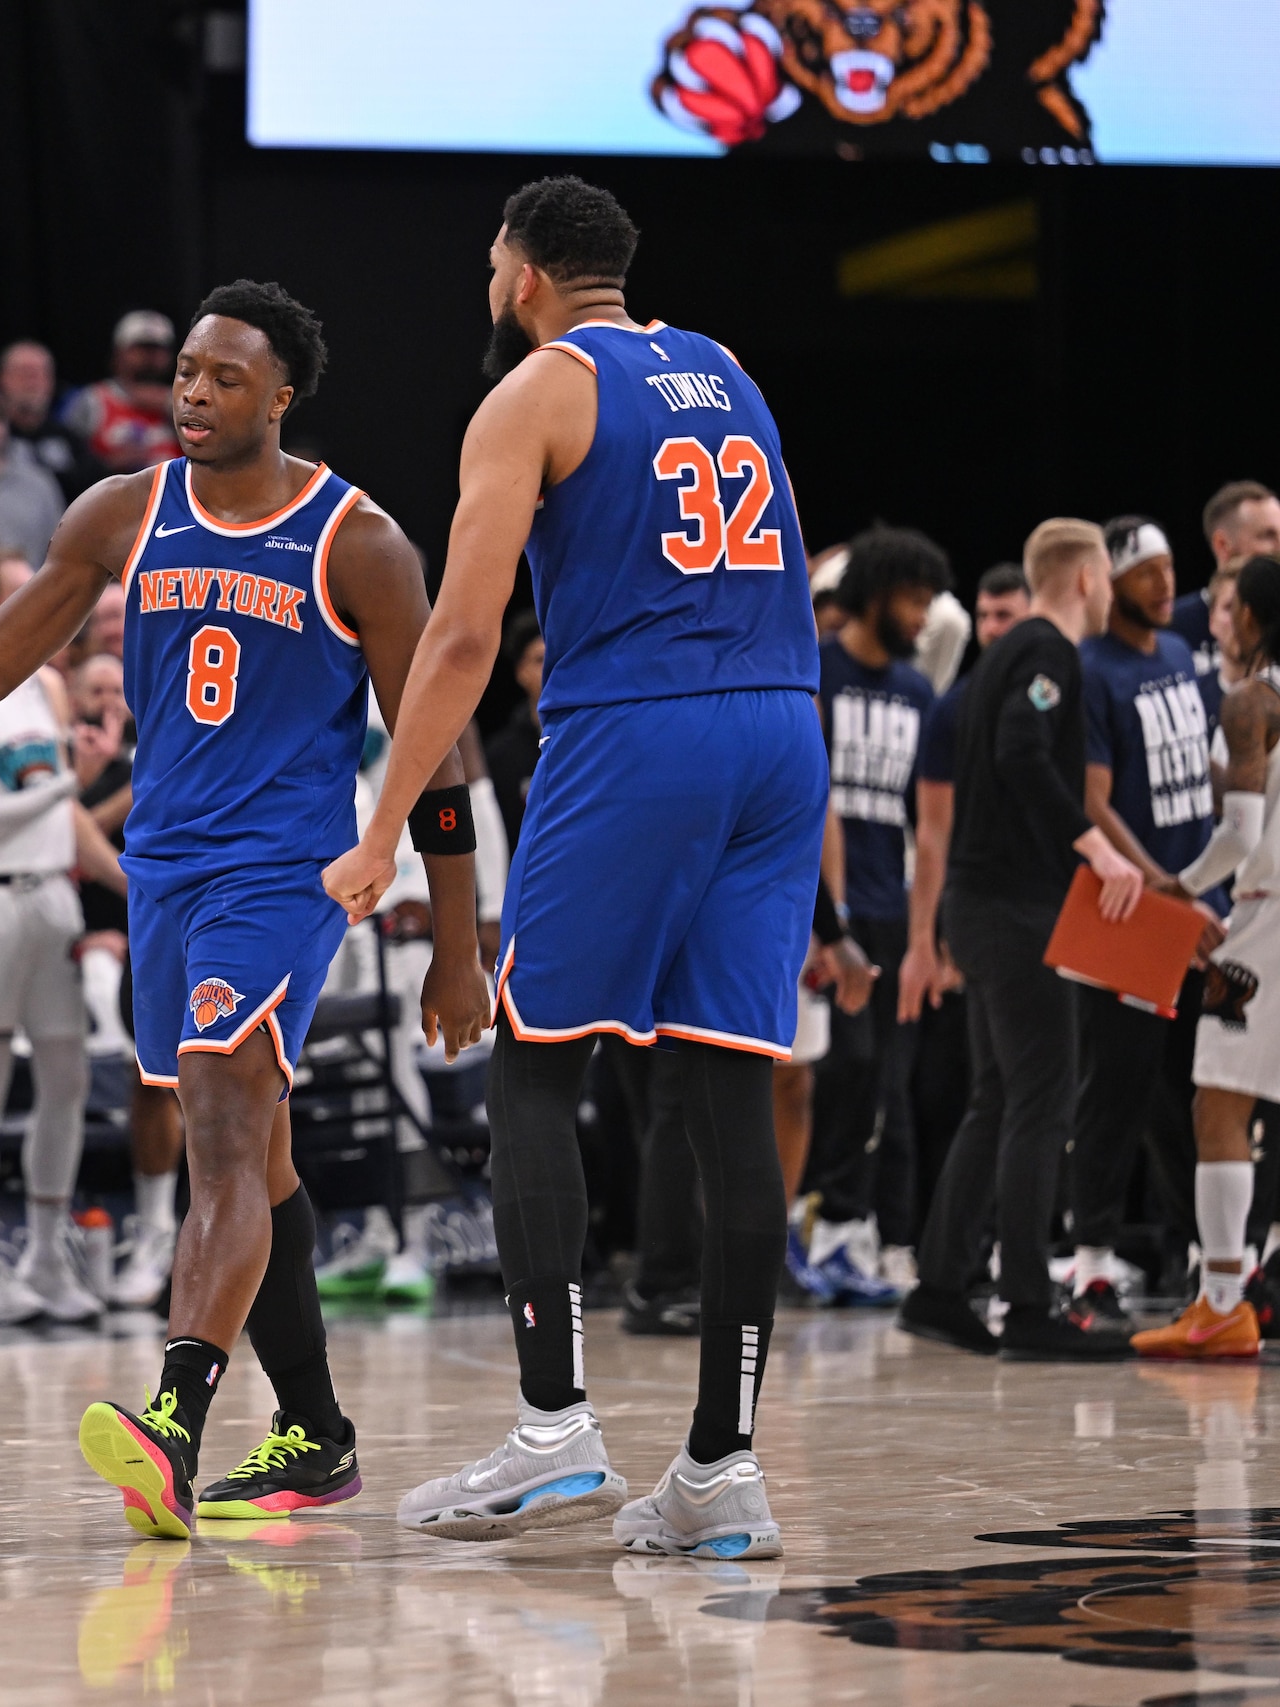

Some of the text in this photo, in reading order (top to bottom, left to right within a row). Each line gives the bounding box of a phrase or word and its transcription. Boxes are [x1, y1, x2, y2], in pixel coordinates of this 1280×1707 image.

[645, 372, 732, 412] TOWNS
[652, 434, 785, 575] 32
[264, 540, 314, 553] abu dhabi
[138, 567, 308, 634] NEW YORK
[185, 624, 242, 727] 8
[438, 807, 457, 831] 8
[191, 983, 234, 1011] KNICKS
